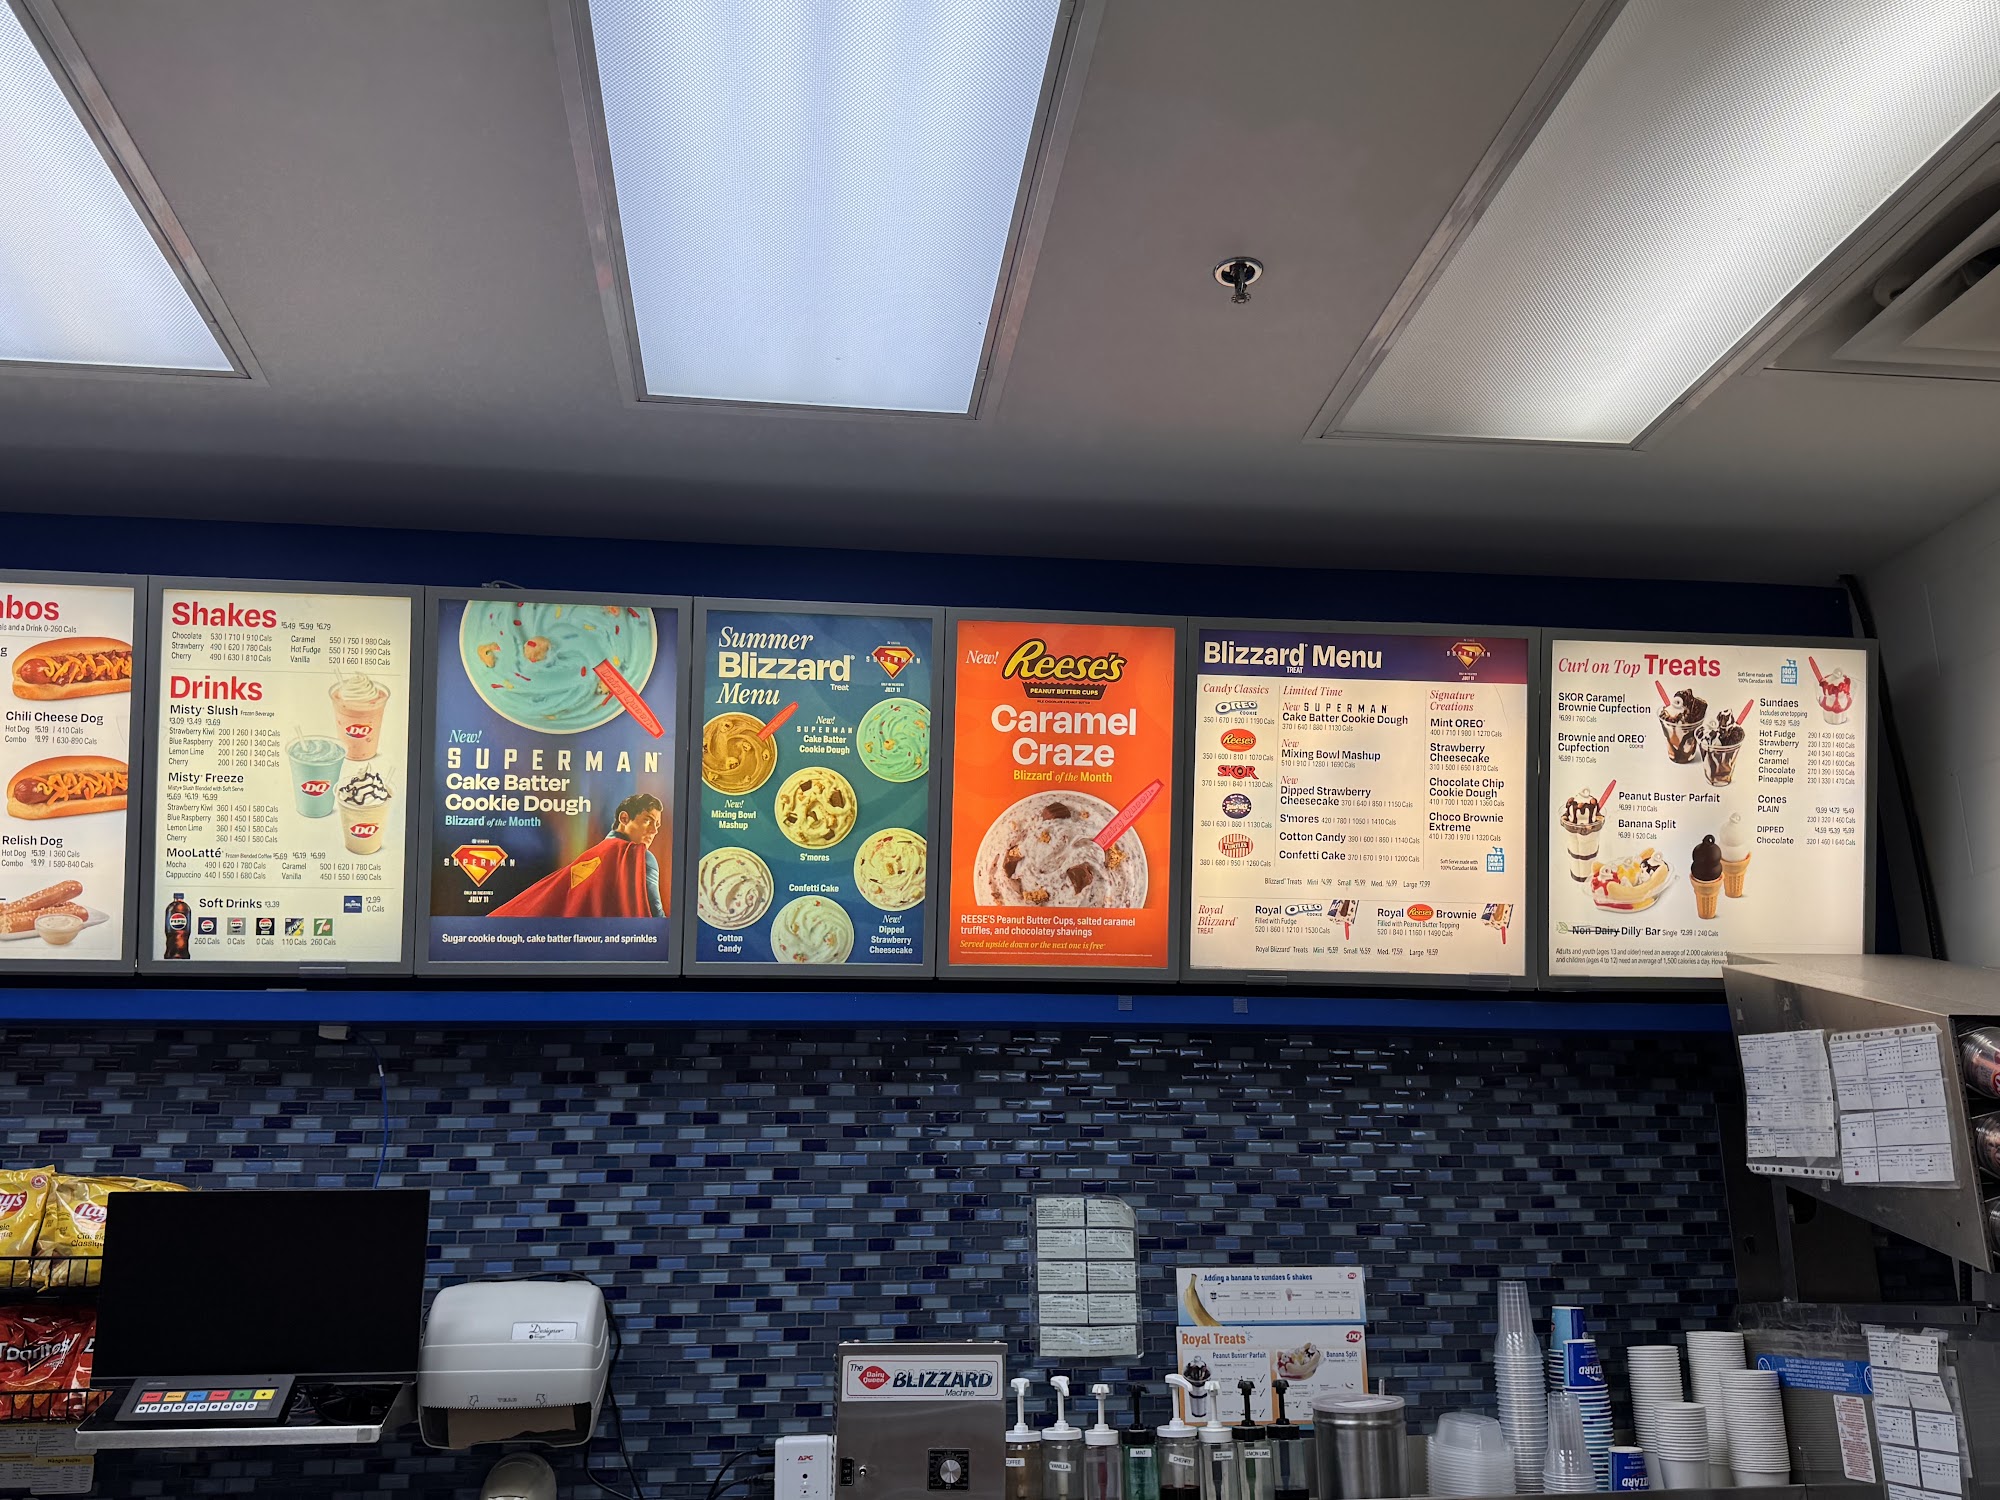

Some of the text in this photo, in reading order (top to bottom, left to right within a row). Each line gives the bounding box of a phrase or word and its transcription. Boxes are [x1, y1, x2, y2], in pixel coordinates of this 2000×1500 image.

[172, 601, 277, 628] Shakes
[172, 631, 202, 640] Chocolate
[291, 635, 316, 643] Caramel
[718, 626, 813, 650] Summer
[965, 650, 999, 665] New!
[1003, 639, 1126, 682] Reese's
[1204, 641, 1382, 669] Blizzard Menu
[718, 651, 850, 682] Blizzard
[1286, 666, 1304, 674] TREAT
[1558, 654, 1721, 678] Curl on Top Treats
[170, 675, 263, 701] Drinks
[830, 683, 849, 691] Treat
[1030, 687, 1056, 695] PEANUT
[1203, 683, 1269, 696] Candy Classics
[1283, 685, 1343, 697] Limited Time
[716, 682, 780, 705] Menu
[1429, 690, 1475, 702] Signature
[1558, 692, 1626, 703] SKOR Caramel
[1216, 701, 1258, 714] OREO
[1282, 702, 1300, 712] New
[1429, 701, 1474, 712] Creations
[1558, 702, 1651, 714] Brownie Cupfection
[1760, 698, 1799, 708] Sundaes
[170, 704, 238, 716] Misty Slush
[6, 711, 104, 725] Chili Cheese Dog
[991, 704, 1137, 736] Caramel
[1282, 712, 1409, 726] Cake Batter Cookie Dough
[1430, 718, 1484, 728] Mint OREO
[169, 727, 201, 736] Strawberry
[449, 730, 482, 743] New!
[1012, 737, 1115, 768] Craze
[447, 748, 659, 773] SUPERMAN
[1013, 769, 1113, 783] Blizzard of the Month
[1217, 764, 1259, 780] SKOR
[446, 773, 570, 792] Cake Batter
[1758, 775, 1794, 784] Pineapple
[1618, 791, 1720, 803] Peanut Buster Parfait
[1757, 795, 1787, 804] Cones
[445, 793, 591, 816] Cookie Dough
[1757, 805, 1780, 813] PLAIN
[711, 810, 757, 819] Mixing Bowl
[1429, 812, 1504, 823] Choco Brownie
[445, 815, 541, 827] Blizzard of the Month
[719, 821, 749, 830] Mashup
[1618, 819, 1677, 830] Banana Split
[1429, 822, 1471, 832] Extreme
[1756, 826, 1784, 834] DIPPED
[2, 835, 63, 848] Relish Dog
[166, 847, 223, 859] MooLatté
[800, 853, 830, 862] S'mores
[789, 883, 839, 893] Confetti Cake
[199, 898, 262, 909] Soft Drinks
[1198, 904, 1223, 915] Royal
[961, 914, 1136, 927] REESE'S Peanut Butter Cups, salted caramel
[1197, 916, 1235, 927] Blizzard
[879, 926, 905, 935] Dipped
[961, 926, 1093, 938] truffles, and chocolatey shavings
[1621, 926, 1661, 937] Dilly Bar
[442, 933, 657, 945] Sugar cookie dough, cake batter flavour, and sprinkles
[717, 934, 743, 942] Cotton
[871, 935, 912, 945] Strawberry
[718, 944, 742, 954] Candy
[869, 945, 913, 954] Cheesecake
[960, 940, 984, 949] Served
[985, 940, 1009, 950] upside
[1009, 940, 1029, 949] down
[1030, 941, 1039, 949] or
[1039, 940, 1051, 949] the
[1052, 941, 1067, 949] next
[1082, 941, 1088, 949] is
[1203, 1273, 1225, 1283] Adding
[1261, 1273, 1286, 1281] sundaes
[1292, 1273, 1313, 1281] shakes
[528, 1323, 564, 1336] Designer
[1181, 1332, 1246, 1348] Royal Treats
[1326, 1350, 1358, 1359] Banana Split
[850, 1363, 885, 1379] The Dairy
[893, 1369, 993, 1388] BLIZZARD
[945, 1388, 975, 1397] Machine
[1173, 1456, 1192, 1465] CHERRY
